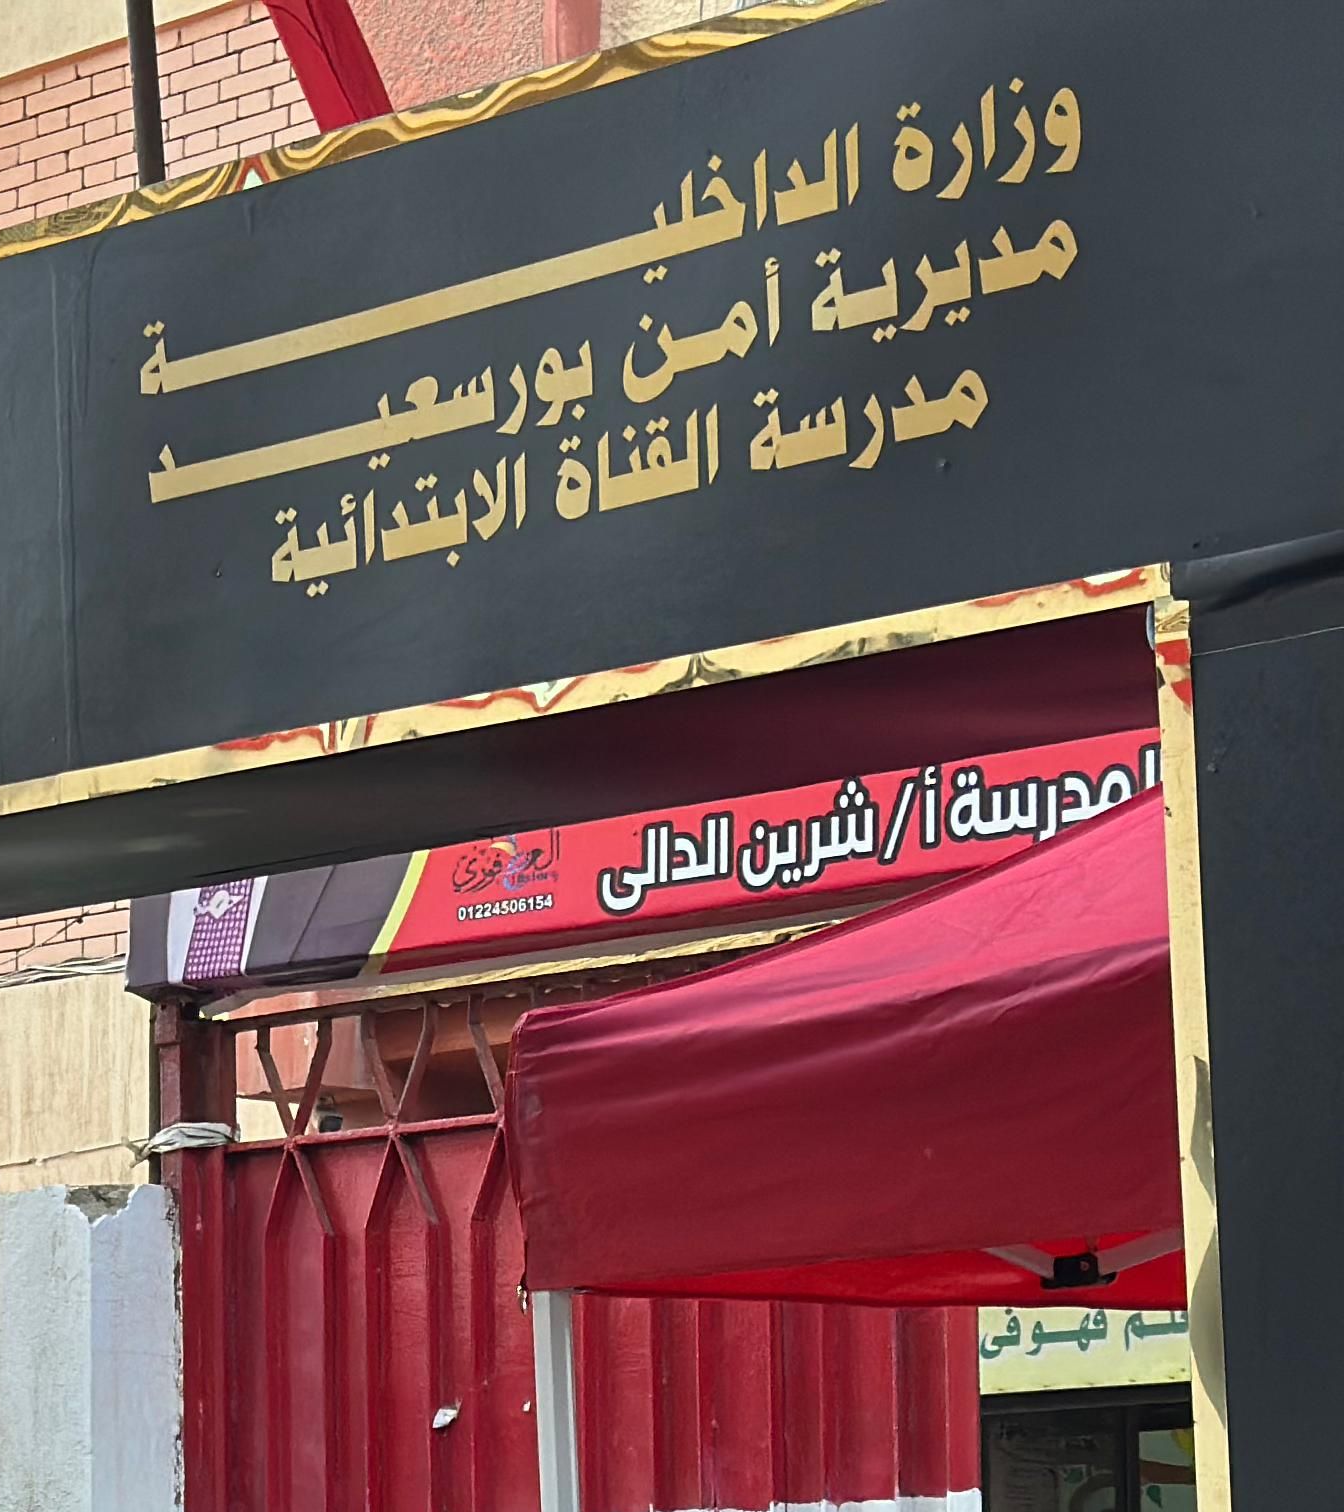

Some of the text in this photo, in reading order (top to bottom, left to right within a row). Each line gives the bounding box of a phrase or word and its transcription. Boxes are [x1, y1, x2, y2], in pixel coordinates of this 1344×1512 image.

[891, 76, 1083, 199] وزارة
[148, 209, 1079, 504] مديرية أمن بورسعيد
[270, 367, 990, 598] مدرسة القناة الابتدائية
[457, 894, 553, 921] 01224506154
